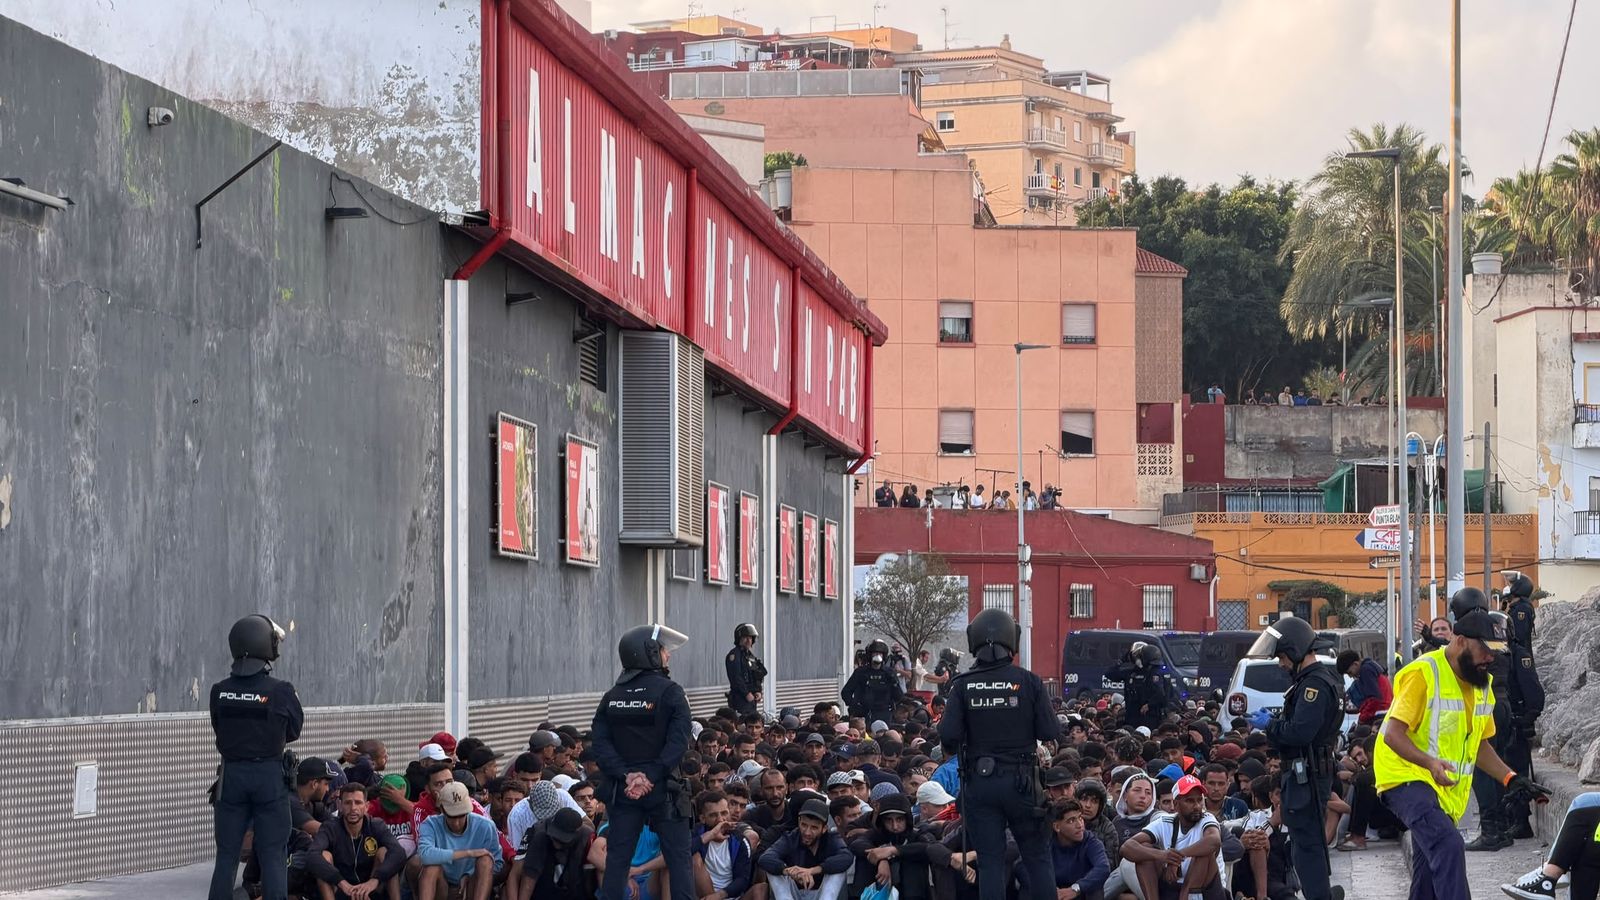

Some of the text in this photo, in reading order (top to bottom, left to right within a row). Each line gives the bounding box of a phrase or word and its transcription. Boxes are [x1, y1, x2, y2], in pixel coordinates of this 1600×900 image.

[527, 68, 750, 353] ALMACNES
[967, 682, 1013, 690] POLICIA
[1102, 681, 1125, 689] NACIO
[219, 692, 262, 702] POLICIA
[609, 700, 648, 708] POLICIA
[971, 698, 1008, 707] U.I.P.
